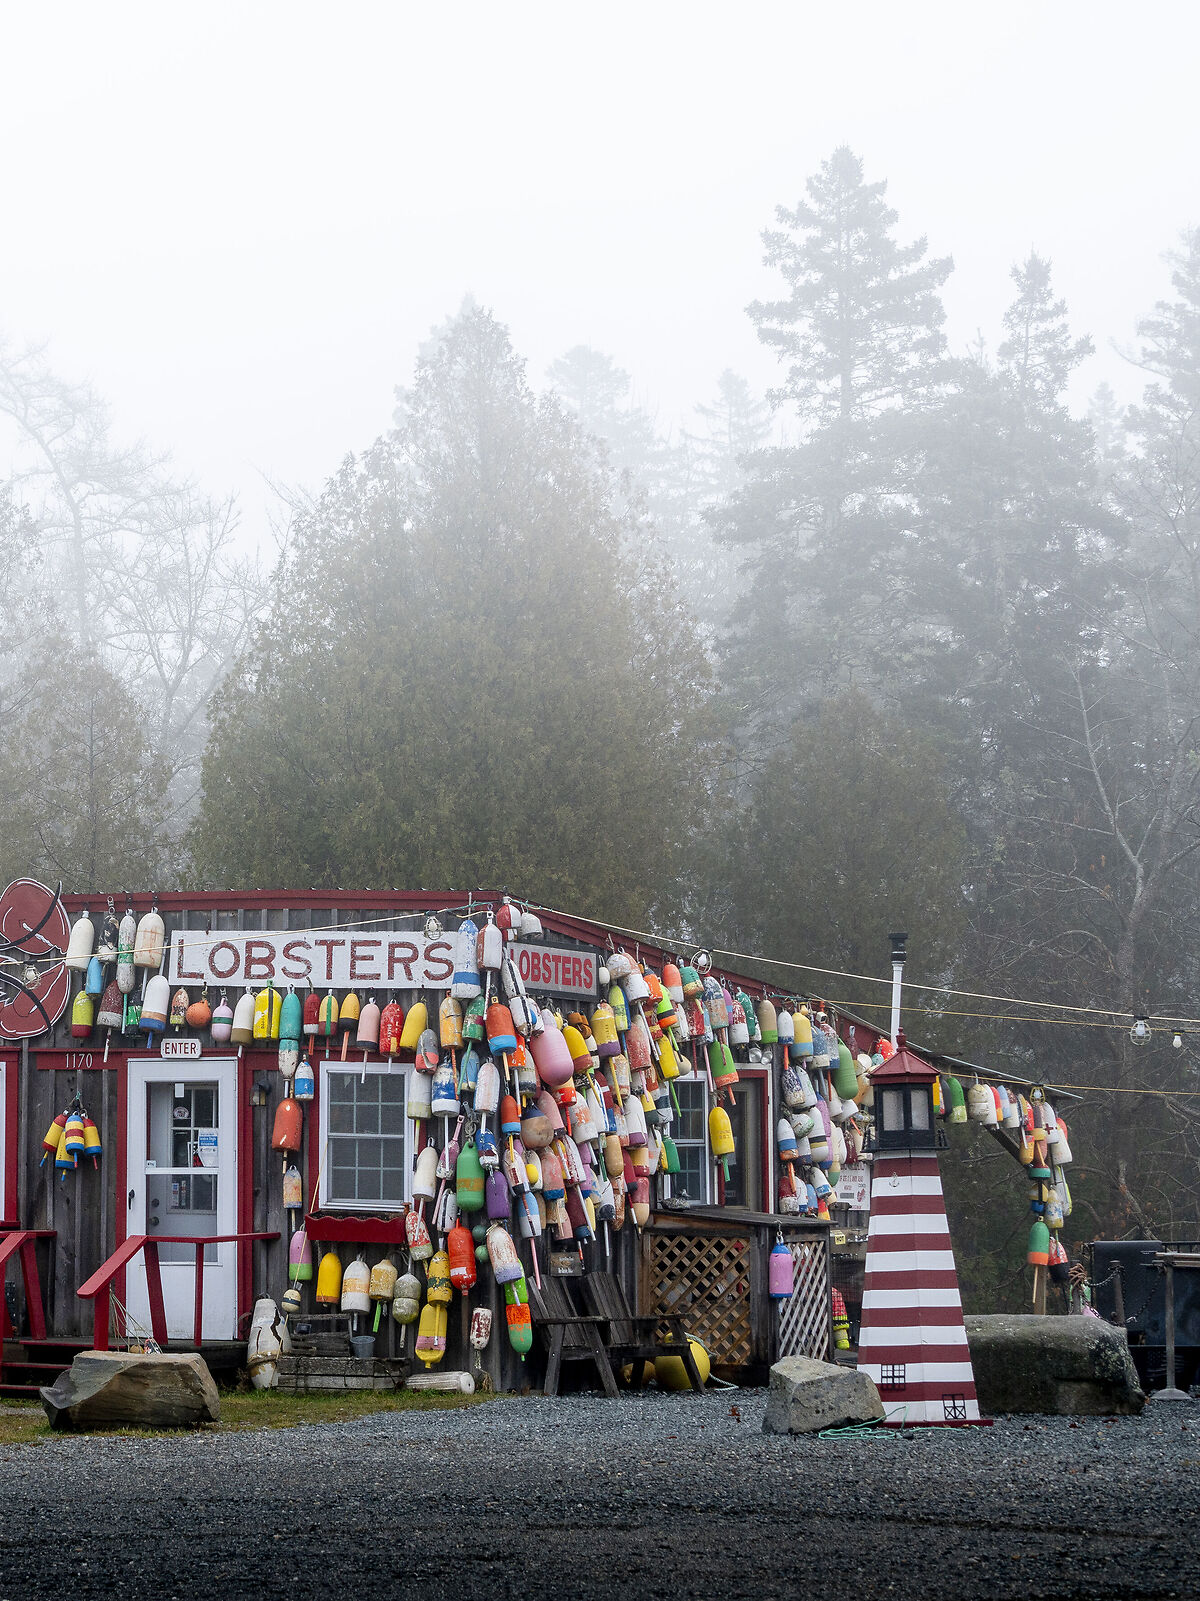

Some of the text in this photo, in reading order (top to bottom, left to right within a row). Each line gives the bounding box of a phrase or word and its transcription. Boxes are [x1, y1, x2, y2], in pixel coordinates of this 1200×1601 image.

[177, 938, 455, 981] LOBSTERS
[164, 1043, 197, 1055] ENTER
[65, 1053, 93, 1069] 1170
